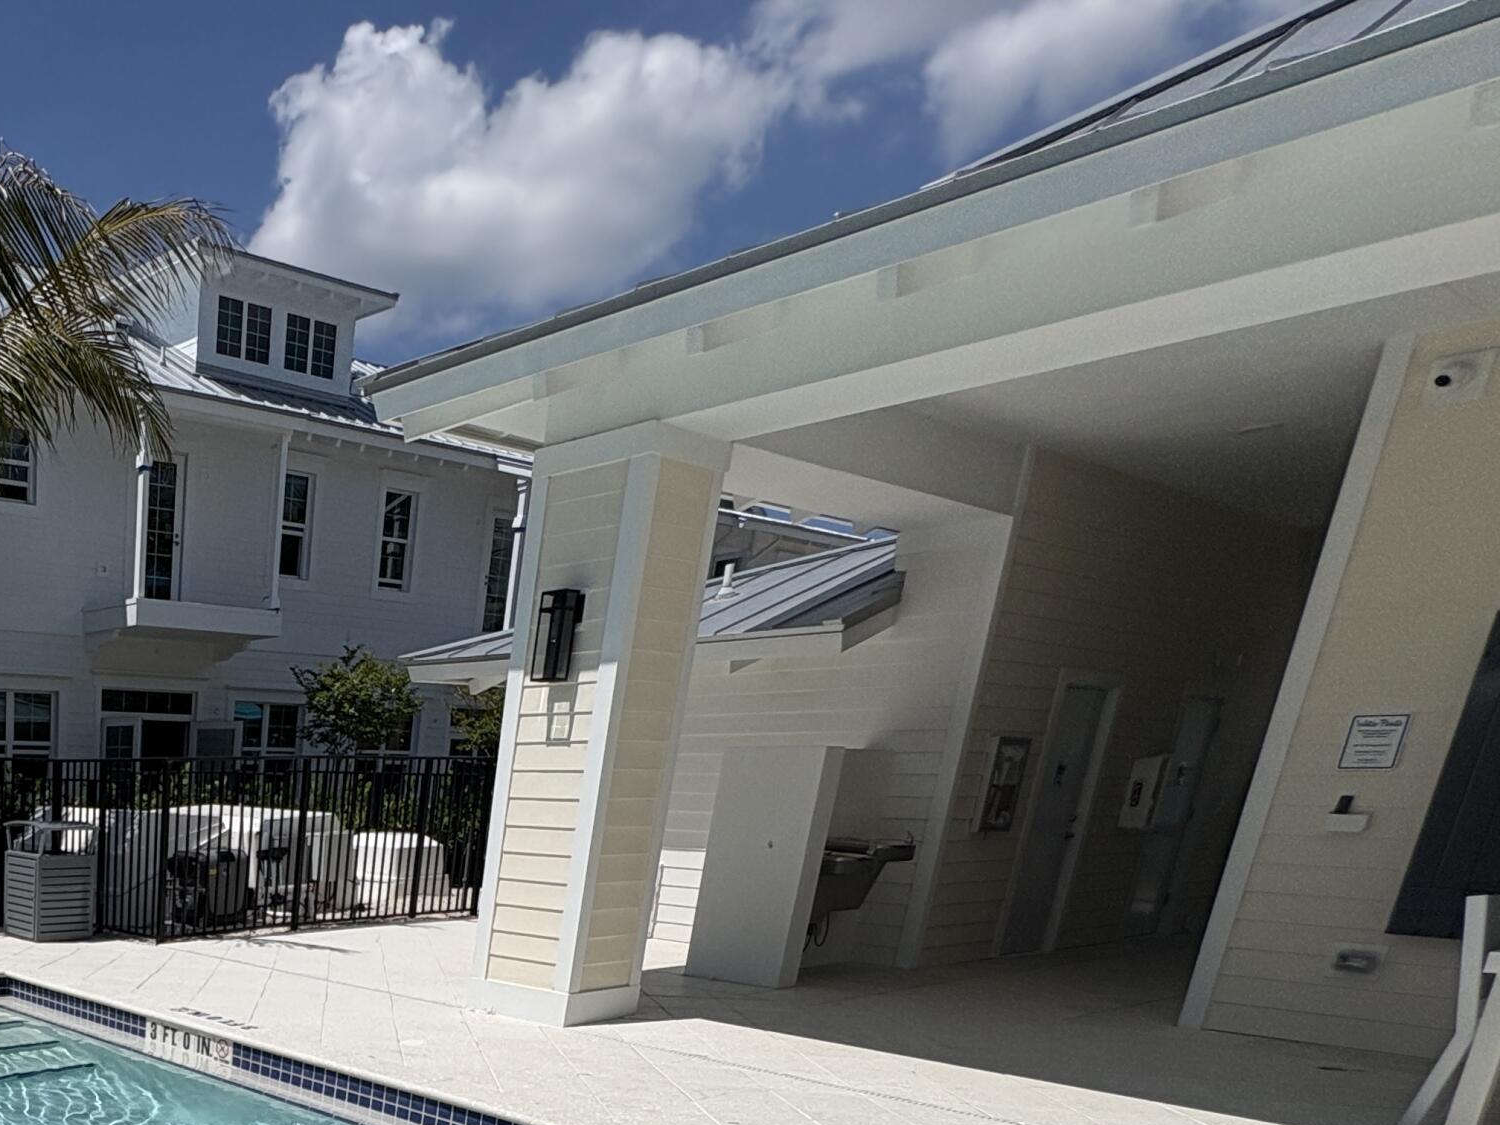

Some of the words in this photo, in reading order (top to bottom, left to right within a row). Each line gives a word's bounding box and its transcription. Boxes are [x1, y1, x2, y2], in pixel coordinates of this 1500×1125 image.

[150, 1022, 157, 1040] 3
[162, 1025, 177, 1046] FT.
[182, 1032, 190, 1050] 0
[196, 1034, 212, 1057] IN.
